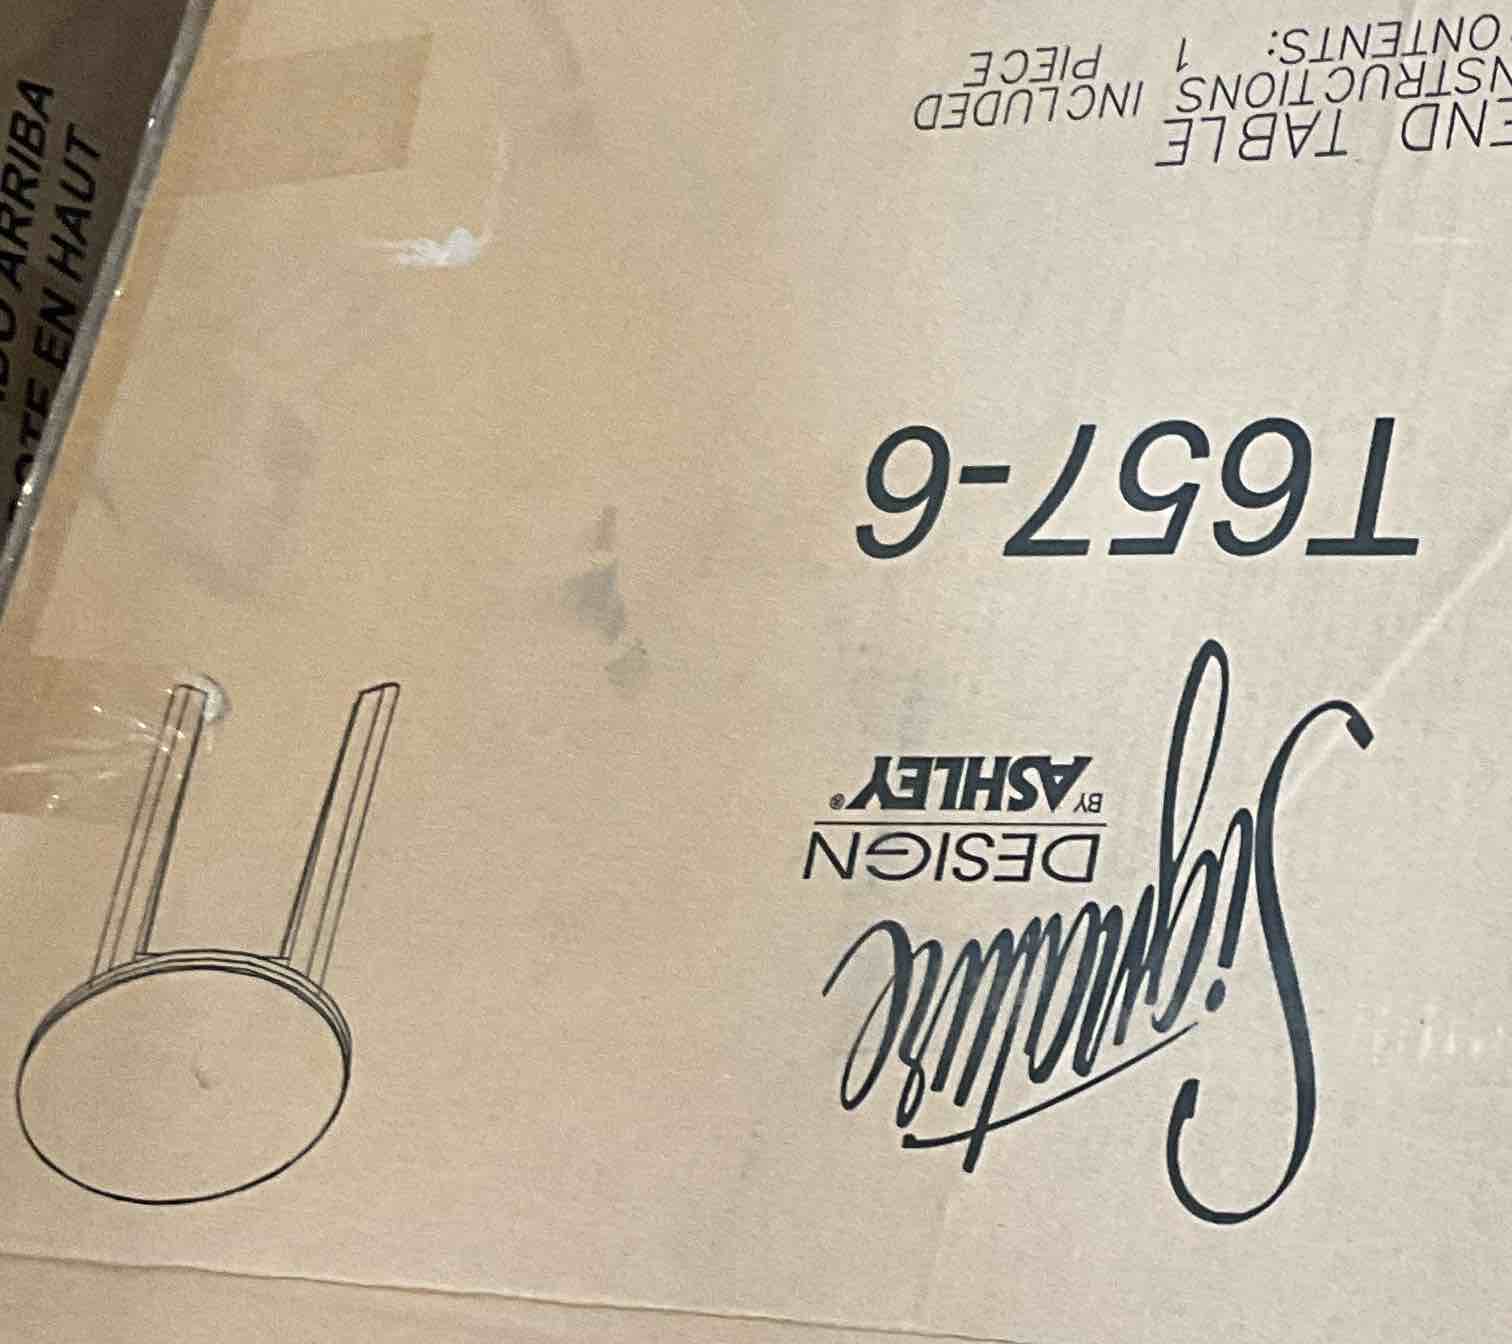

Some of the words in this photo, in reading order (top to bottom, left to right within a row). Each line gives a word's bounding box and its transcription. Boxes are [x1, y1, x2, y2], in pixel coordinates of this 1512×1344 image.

[963, 43, 1102, 87] PIECE
[1176, 37, 1187, 73] 1
[914, 80, 1143, 130] INCLUDED
[1154, 108, 1348, 167] TABLE
[0, 79, 55, 288] ARRIBA
[48, 121, 102, 284] HAUT
[33, 286, 80, 371] EN
[855, 416, 1420, 558] T657-6
[1076, 793, 1104, 813] BY
[803, 830, 1102, 883] DESIGN
